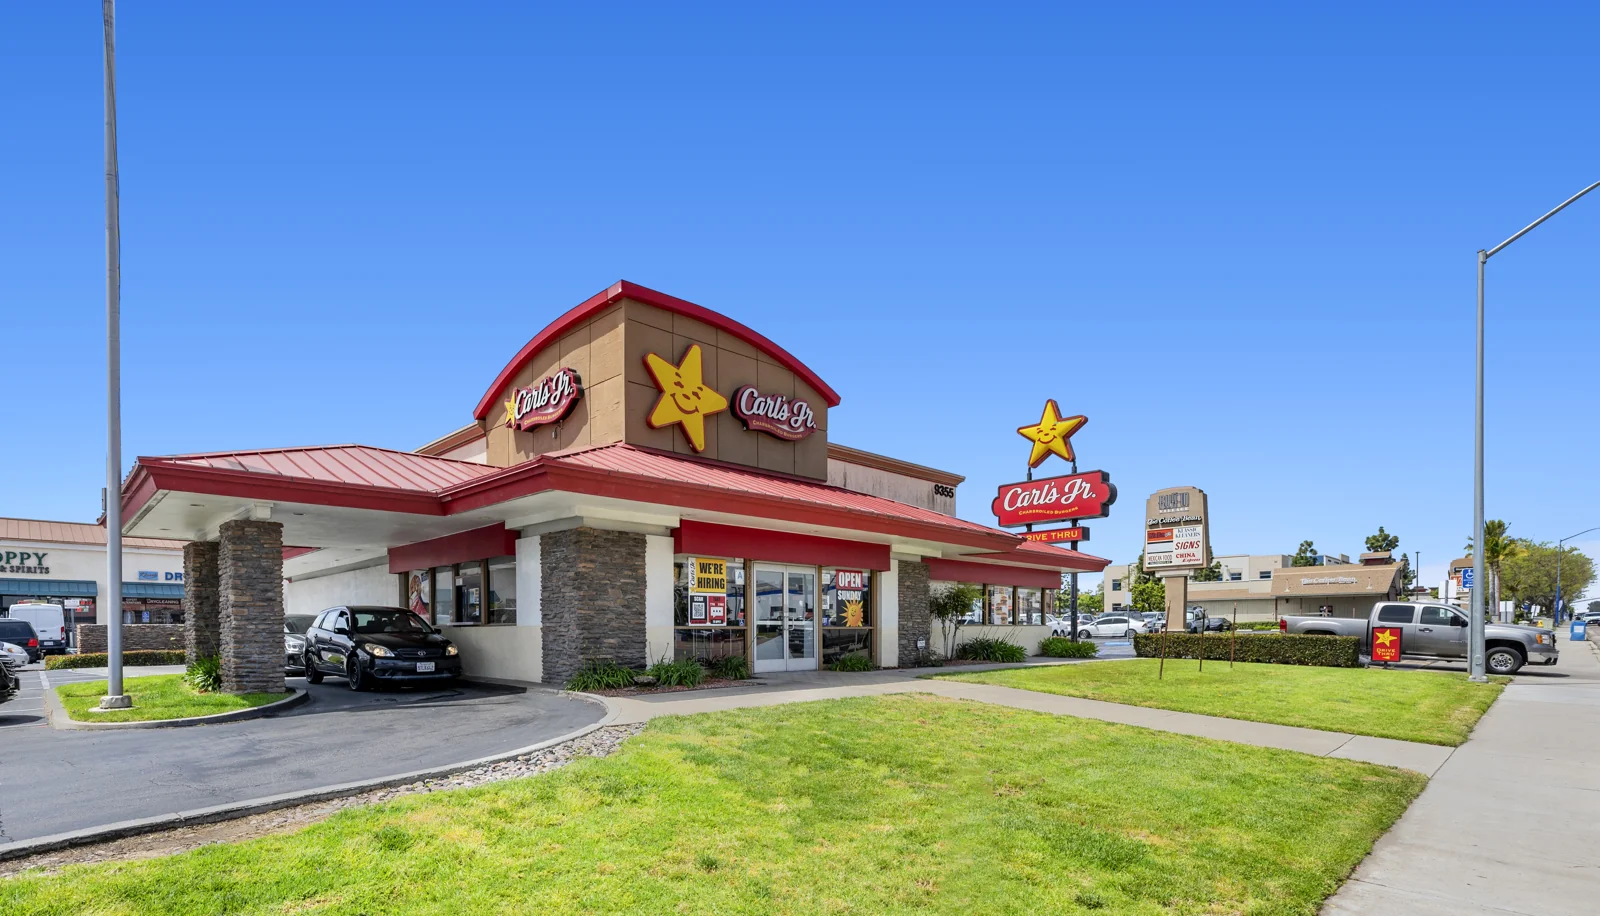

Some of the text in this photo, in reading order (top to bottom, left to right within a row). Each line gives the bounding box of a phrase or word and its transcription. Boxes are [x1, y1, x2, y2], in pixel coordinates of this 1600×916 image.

[514, 370, 573, 419] Carl's Jr.
[740, 387, 817, 429] Carl's Jr.
[934, 484, 954, 498] 9355
[1003, 478, 1096, 511] Carl's Jr.
[1026, 530, 1078, 541] RIVE THRU
[1175, 540, 1200, 551] SIGNS
[0, 551, 48, 566] PPY
[9, 565, 50, 575] SPIRITS
[699, 562, 723, 575] WE'RE
[697, 577, 725, 590] HIRING
[838, 571, 861, 588] OPEN
[837, 590, 862, 601] SUNDAY
